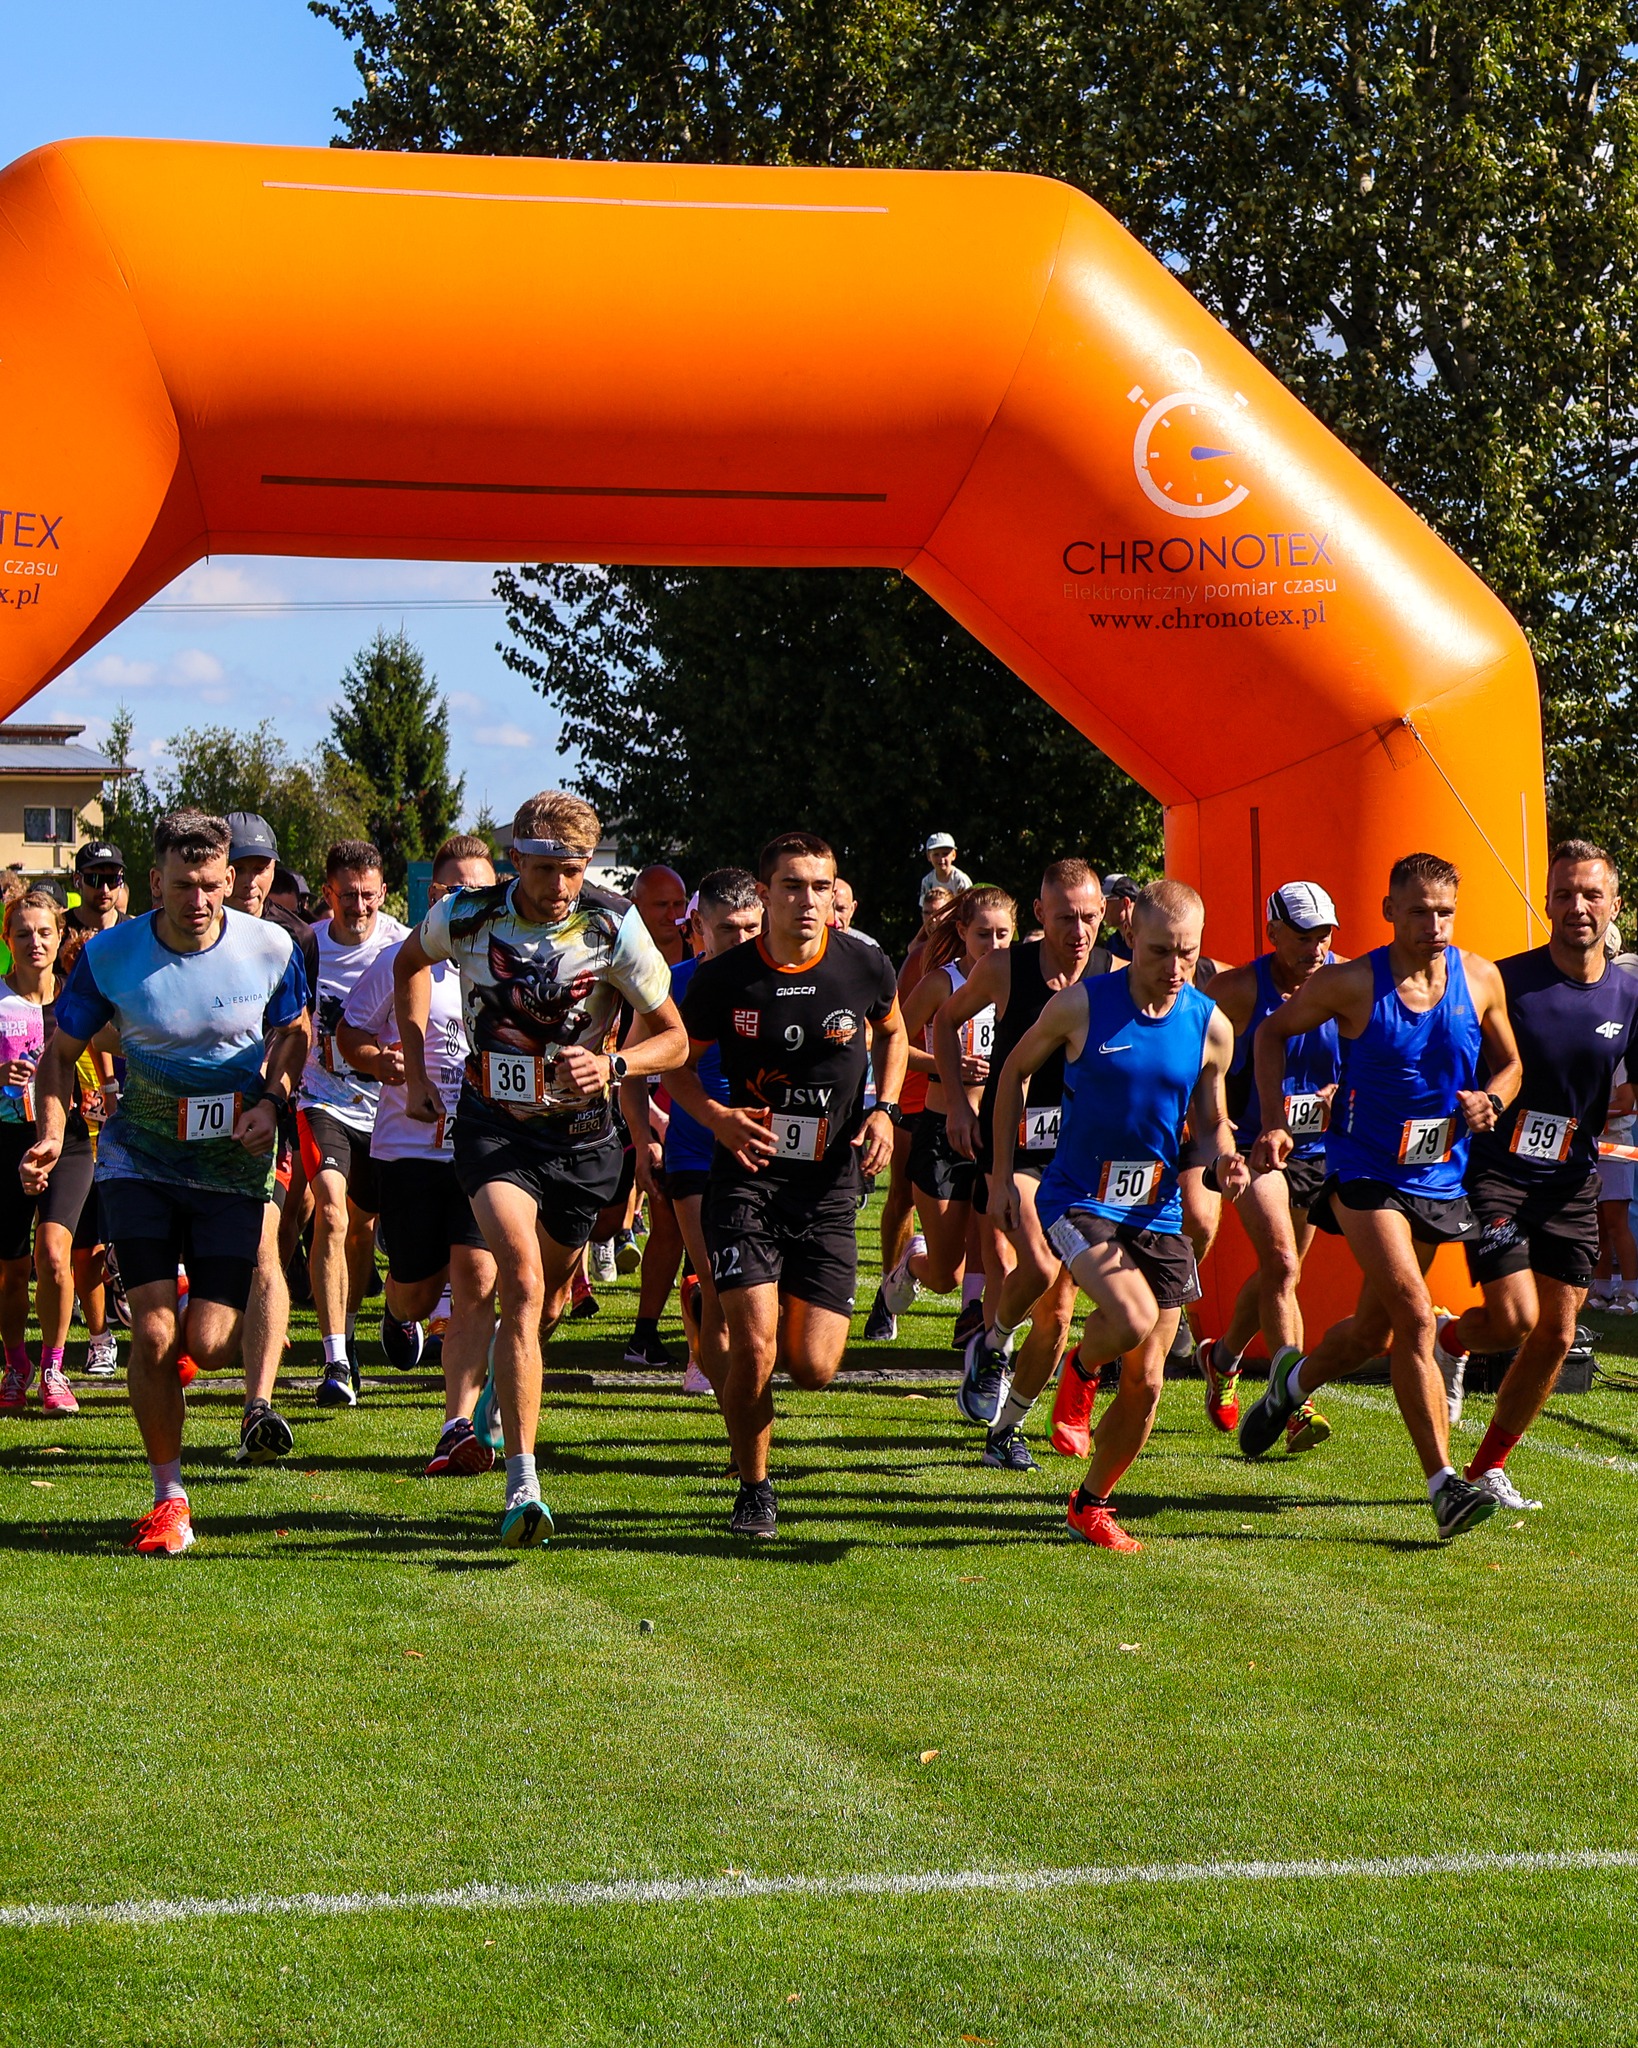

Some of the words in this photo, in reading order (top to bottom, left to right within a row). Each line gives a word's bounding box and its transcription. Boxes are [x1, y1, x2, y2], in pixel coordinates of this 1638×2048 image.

[3, 559, 59, 576] czasu
[1062, 533, 1334, 575] CHRONOTEX
[1063, 581, 1198, 603] Elektroniczny
[1204, 579, 1278, 603] pomiar
[1283, 577, 1338, 595] czasu
[1088, 600, 1327, 630] www.chronotex.pl
[784, 1024, 805, 1051] 9
[980, 1023, 994, 1048] 8
[1595, 1020, 1624, 1039] 4F
[497, 1062, 526, 1092] 36
[780, 1088, 833, 1108] JSW
[197, 1102, 224, 1131] 70
[1291, 1101, 1320, 1127] 192
[786, 1123, 801, 1150] 9
[1034, 1115, 1060, 1141] 44
[1415, 1127, 1440, 1155] 79
[1528, 1120, 1558, 1149] 59
[1115, 1169, 1145, 1197] 50
[712, 1246, 743, 1281] 22
